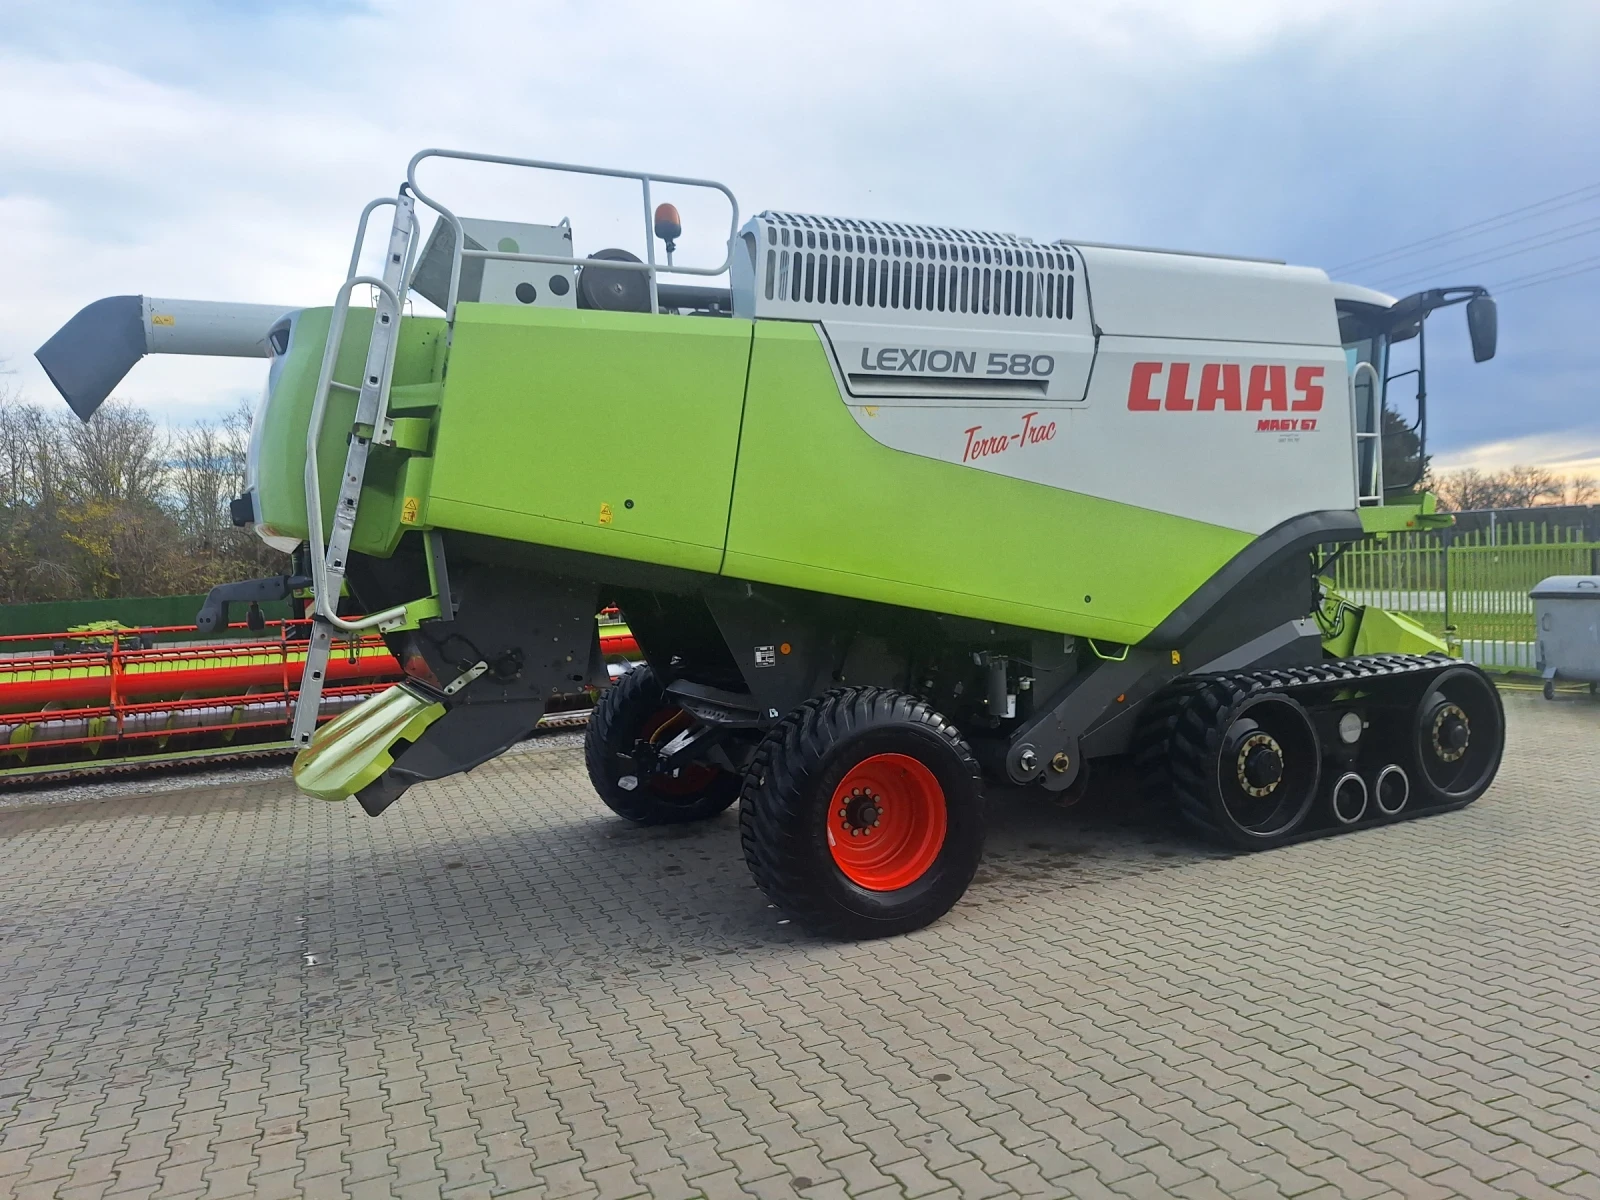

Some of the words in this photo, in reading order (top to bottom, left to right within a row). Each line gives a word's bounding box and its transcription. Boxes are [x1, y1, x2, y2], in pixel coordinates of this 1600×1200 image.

[861, 347, 977, 374] LEXION
[986, 353, 1055, 377] 580
[1127, 361, 1325, 412] CLAAS
[962, 411, 1057, 463] Terra-Trac
